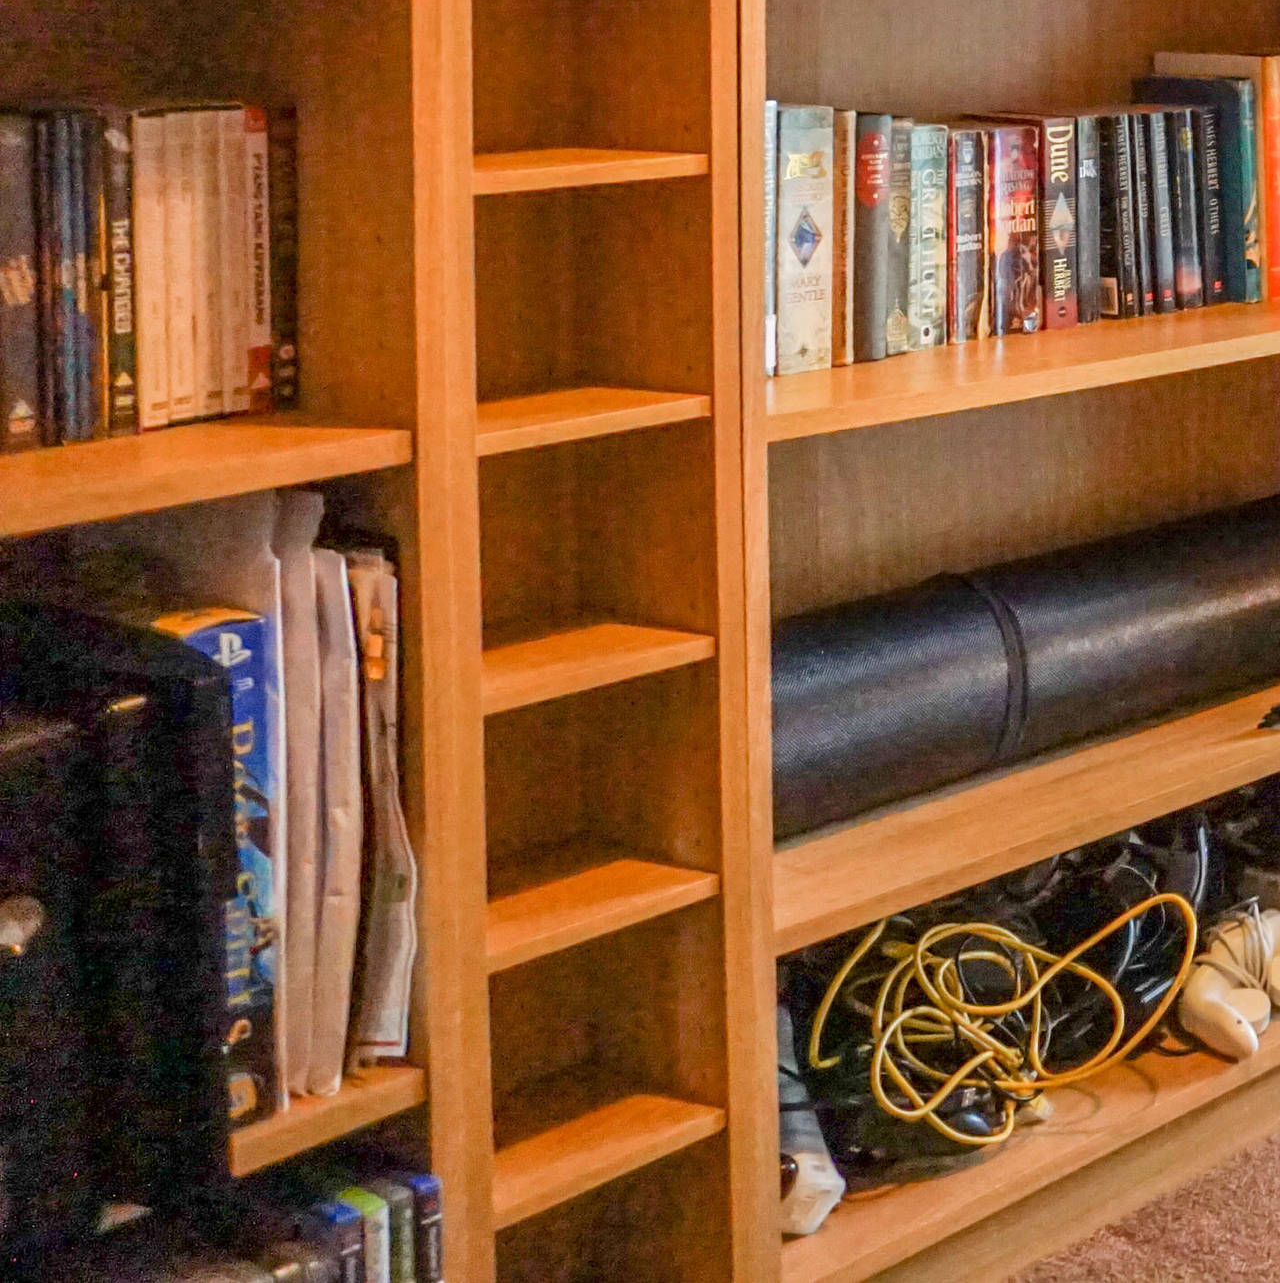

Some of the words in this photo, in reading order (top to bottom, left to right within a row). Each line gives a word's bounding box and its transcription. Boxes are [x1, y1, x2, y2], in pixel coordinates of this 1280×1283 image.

[1156, 122, 1166, 152] JAMES
[1203, 113, 1216, 147] JAMES
[1046, 124, 1074, 184] Dune
[1157, 152, 1168, 189] HERBERT
[1206, 148, 1220, 191] HERBERT
[1118, 155, 1128, 192] HERBERT
[921, 168, 936, 240] GREAT
[998, 199, 1035, 215] obert
[1159, 205, 1170, 237] CREED
[1208, 197, 1221, 235] OTHERS
[998, 215, 1036, 233] ordan
[921, 249, 936, 318] HUNT
[1053, 257, 1068, 303] HERBERT
